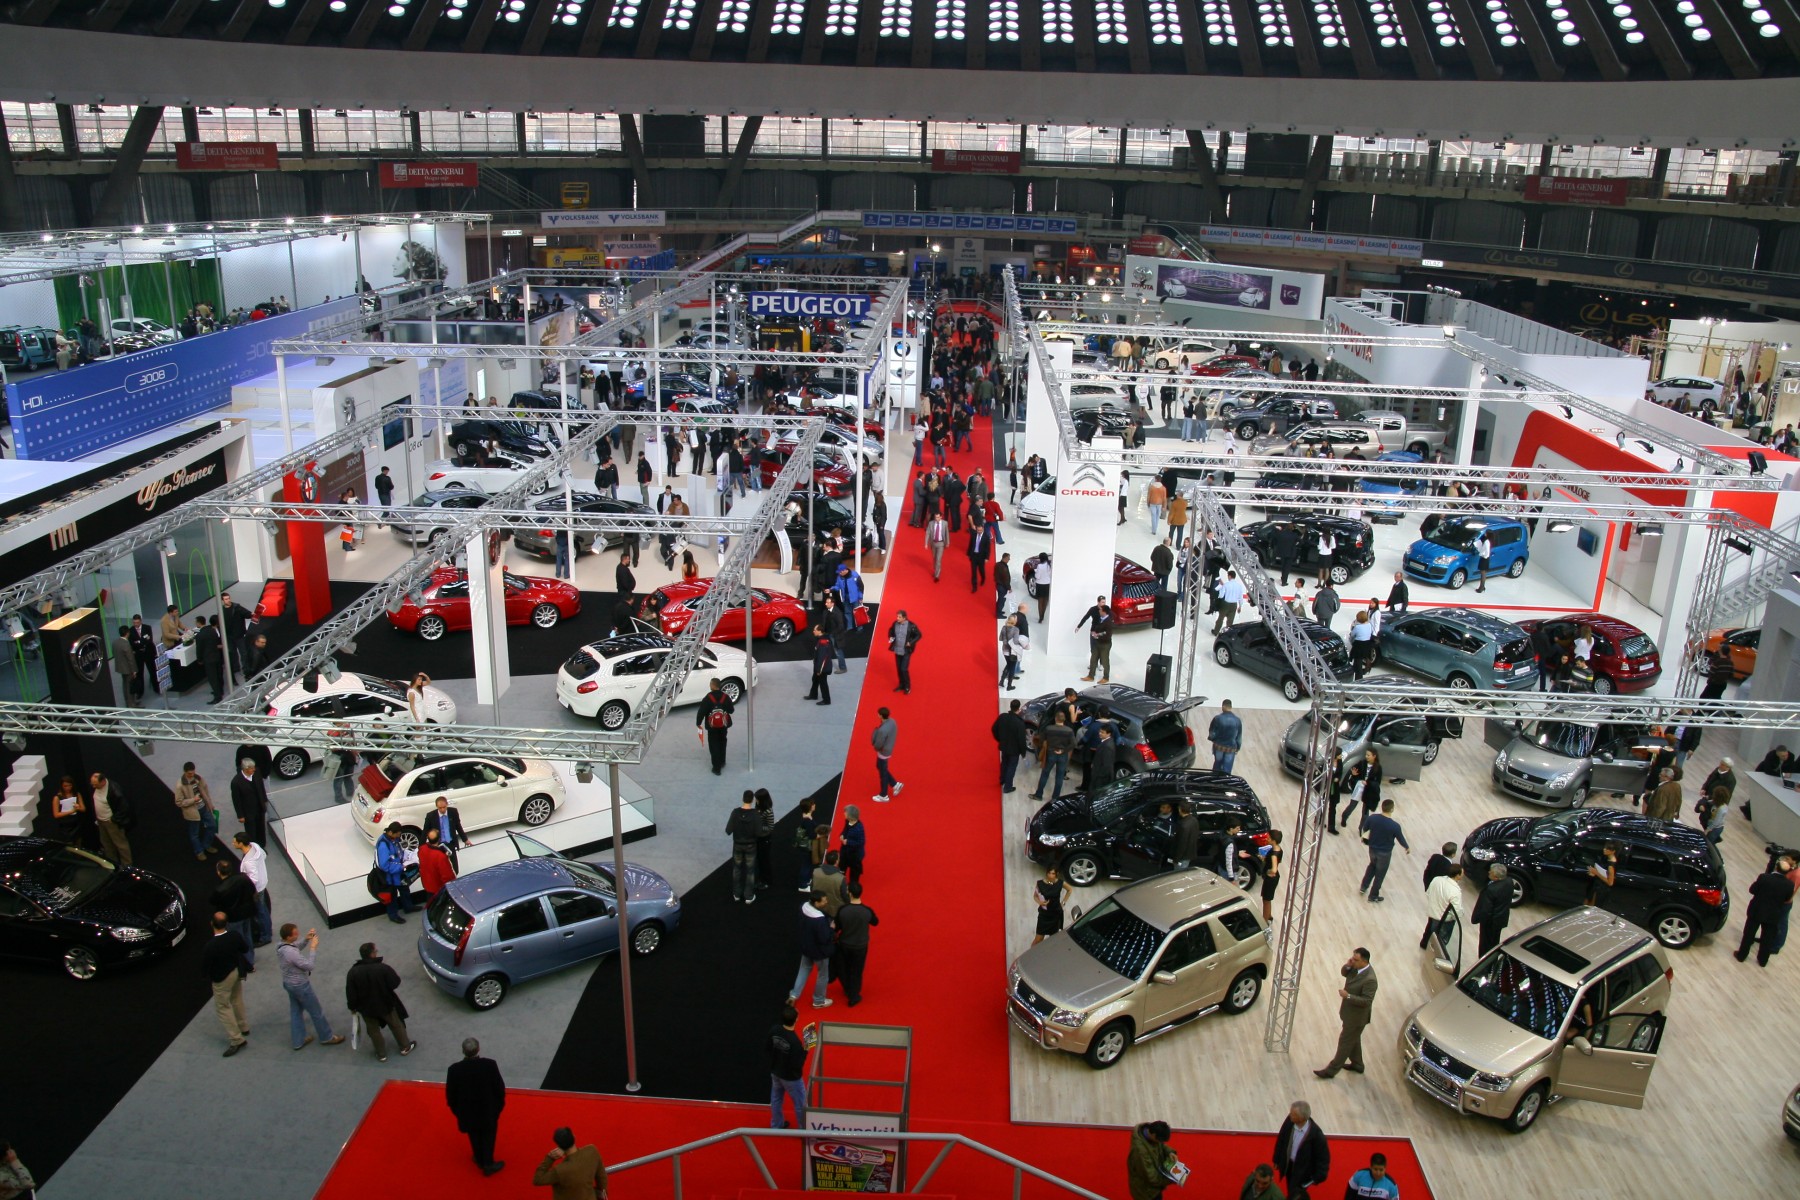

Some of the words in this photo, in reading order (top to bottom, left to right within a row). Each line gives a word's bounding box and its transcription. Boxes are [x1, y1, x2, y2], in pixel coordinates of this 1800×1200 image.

[206, 147, 230, 156] DELTA
[230, 147, 265, 155] GENERALI
[408, 167, 430, 176] DELTA
[430, 167, 464, 176] GENERALI
[1554, 181, 1576, 190] DELTA
[1576, 183, 1614, 192] GENERALI
[1207, 229, 1230, 237] LEASING
[1504, 254, 1558, 268] LEXUS
[1709, 273, 1769, 290] LEXUS
[752, 295, 866, 315] PEUGEOT
[1612, 311, 1668, 329] LEX
[139, 369, 166, 386] 3008
[22, 395, 43, 411] HDI
[137, 477, 172, 511] Alfa
[172, 463, 216, 490] Romeo
